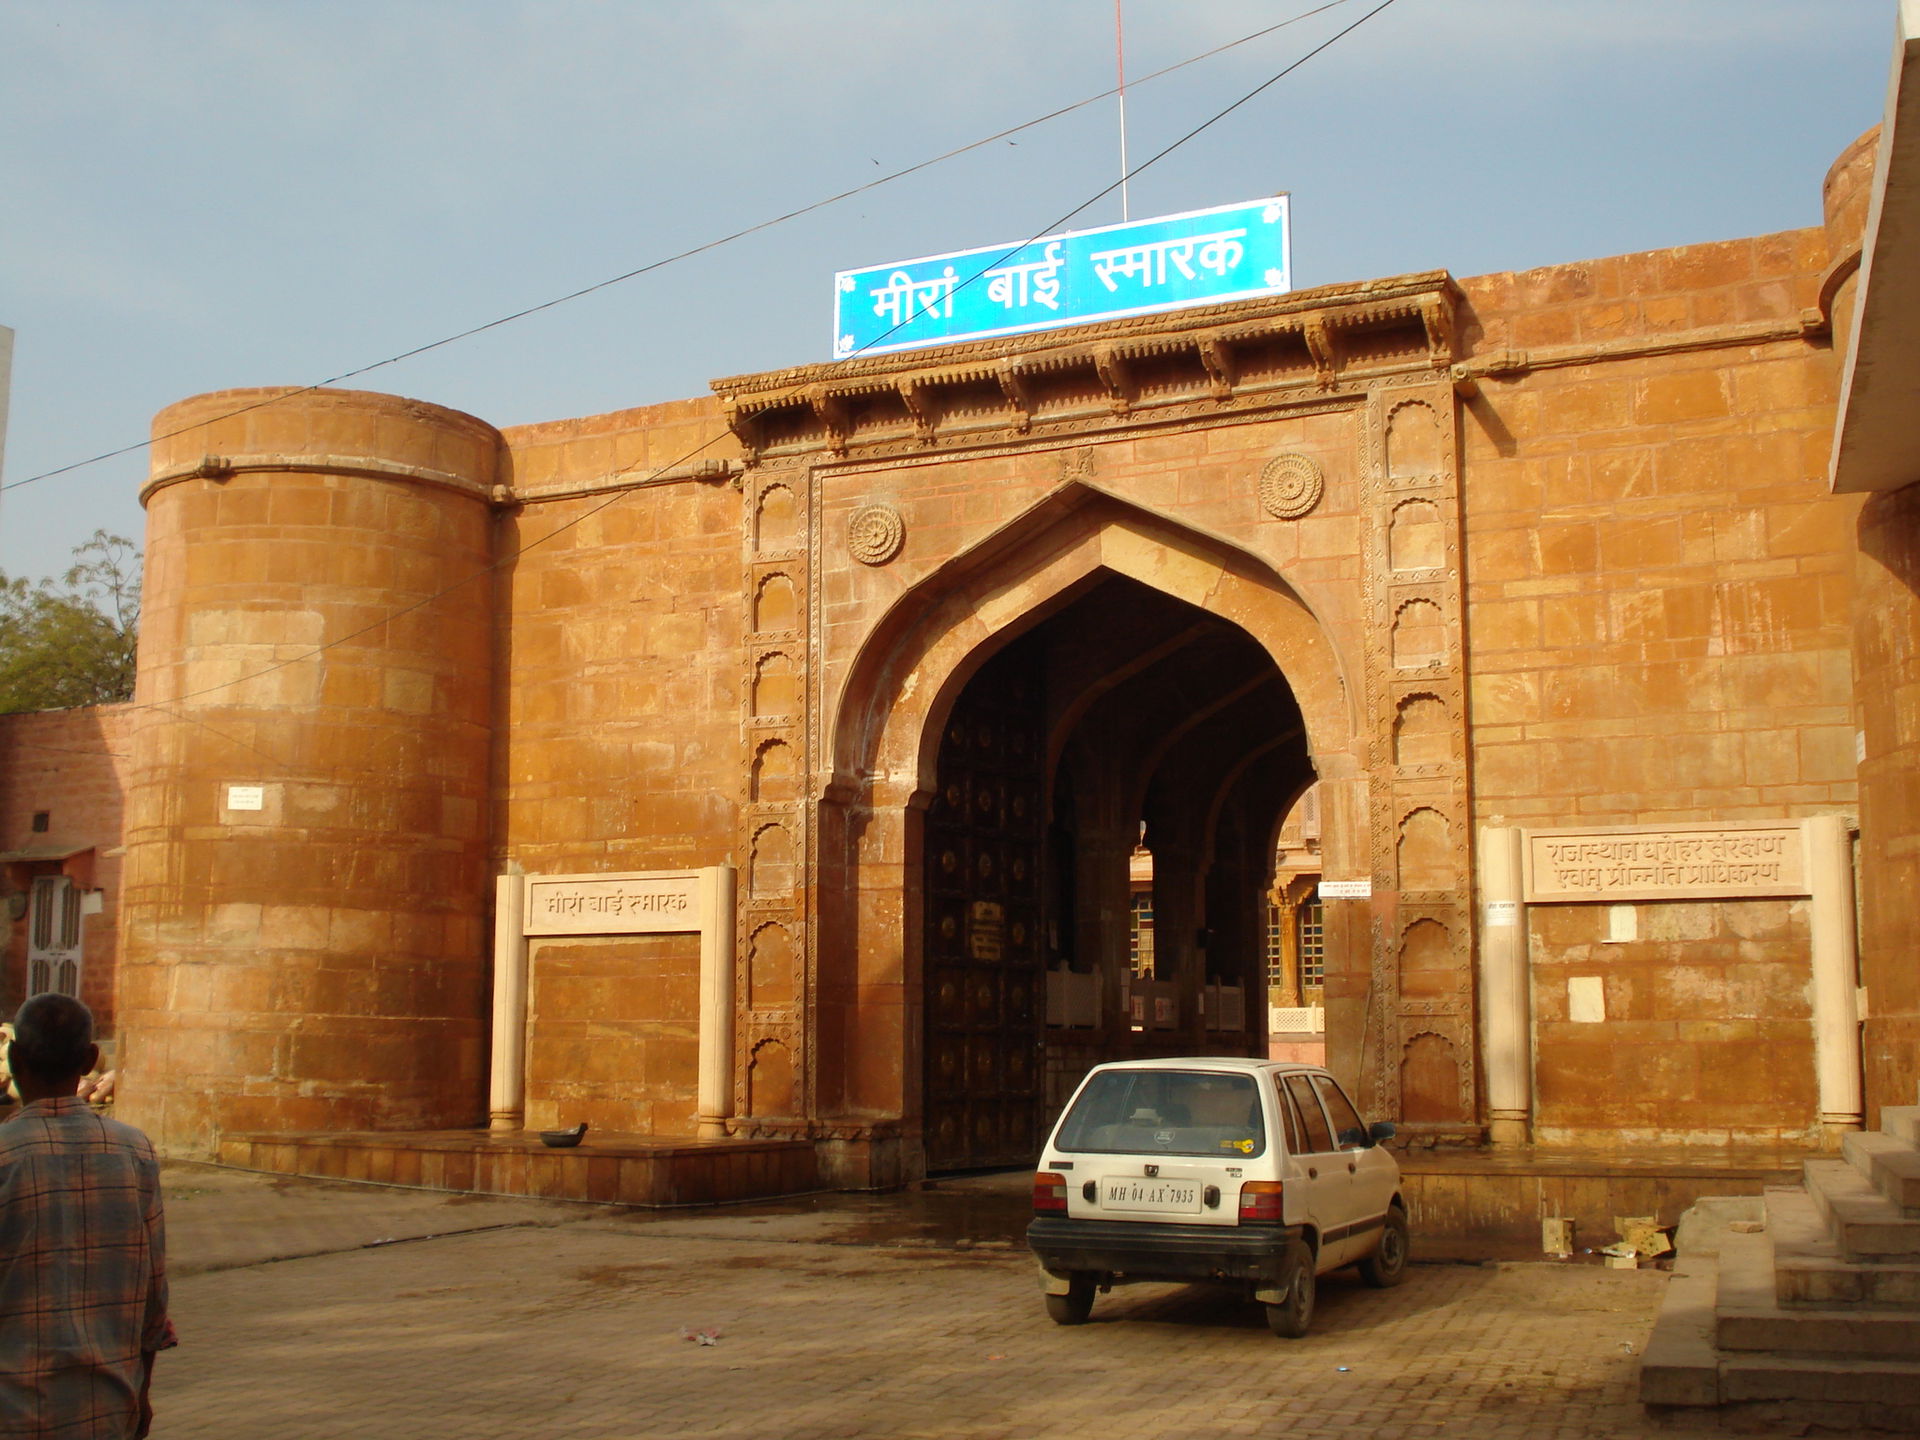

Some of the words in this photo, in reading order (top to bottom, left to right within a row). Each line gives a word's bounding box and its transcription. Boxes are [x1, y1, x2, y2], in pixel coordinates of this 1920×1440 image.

[869, 265, 960, 327] मीरां
[983, 241, 1065, 312] बाई
[1089, 227, 1248, 293] स्मारक
[1545, 842, 1640, 866] राजस्थान
[1641, 834, 1704, 862] धरोहर
[1705, 833, 1787, 859] संरक्षण
[1553, 867, 1604, 891] एवम्
[1686, 859, 1781, 886] प्राधिकरण
[544, 890, 585, 918] मीरां
[627, 892, 688, 916] स्मारक
[1108, 1186, 1127, 1201] MH
[1131, 1187, 1144, 1202] 04
[1148, 1187, 1165, 1203] AX
[1169, 1189, 1195, 1204] 7935
